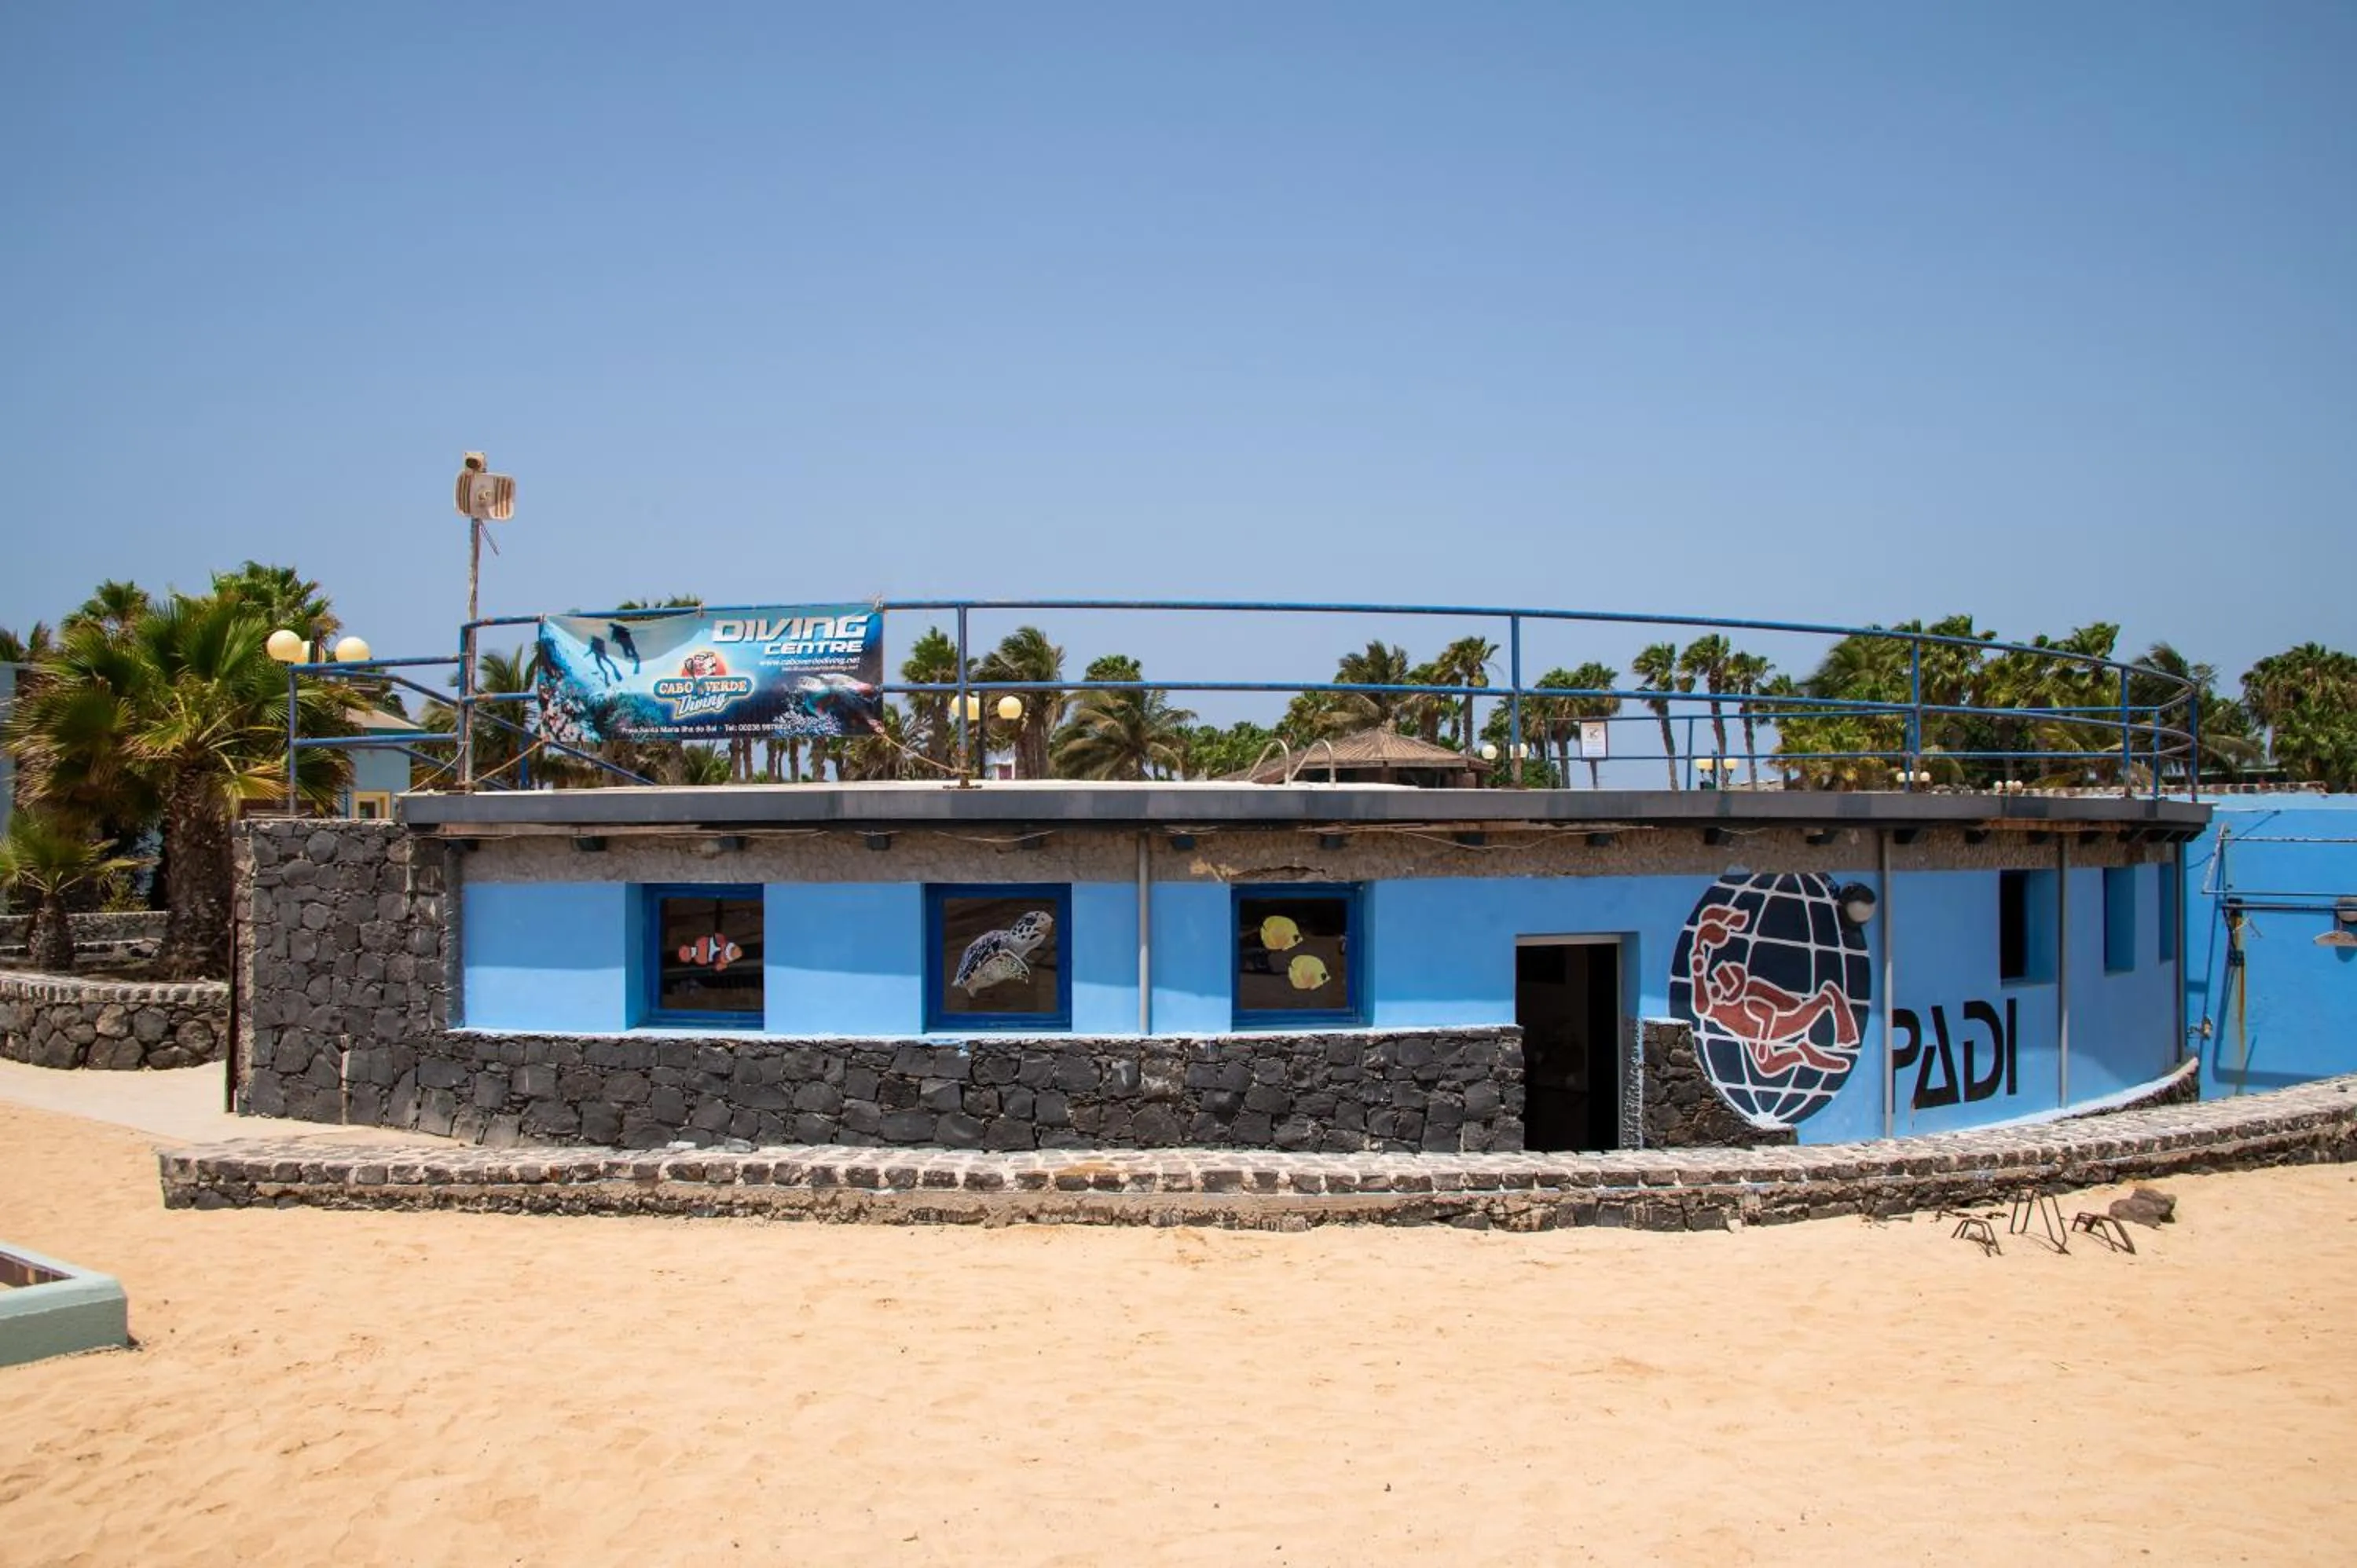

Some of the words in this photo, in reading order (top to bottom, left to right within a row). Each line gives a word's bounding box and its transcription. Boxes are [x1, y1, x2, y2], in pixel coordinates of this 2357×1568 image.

[713, 615, 868, 643] DIVING
[764, 641, 863, 654] CENTRE
[660, 681, 693, 694] CABO
[704, 680, 747, 692] VERDE
[677, 693, 727, 715] Diving
[1889, 997, 2017, 1114] PADI
